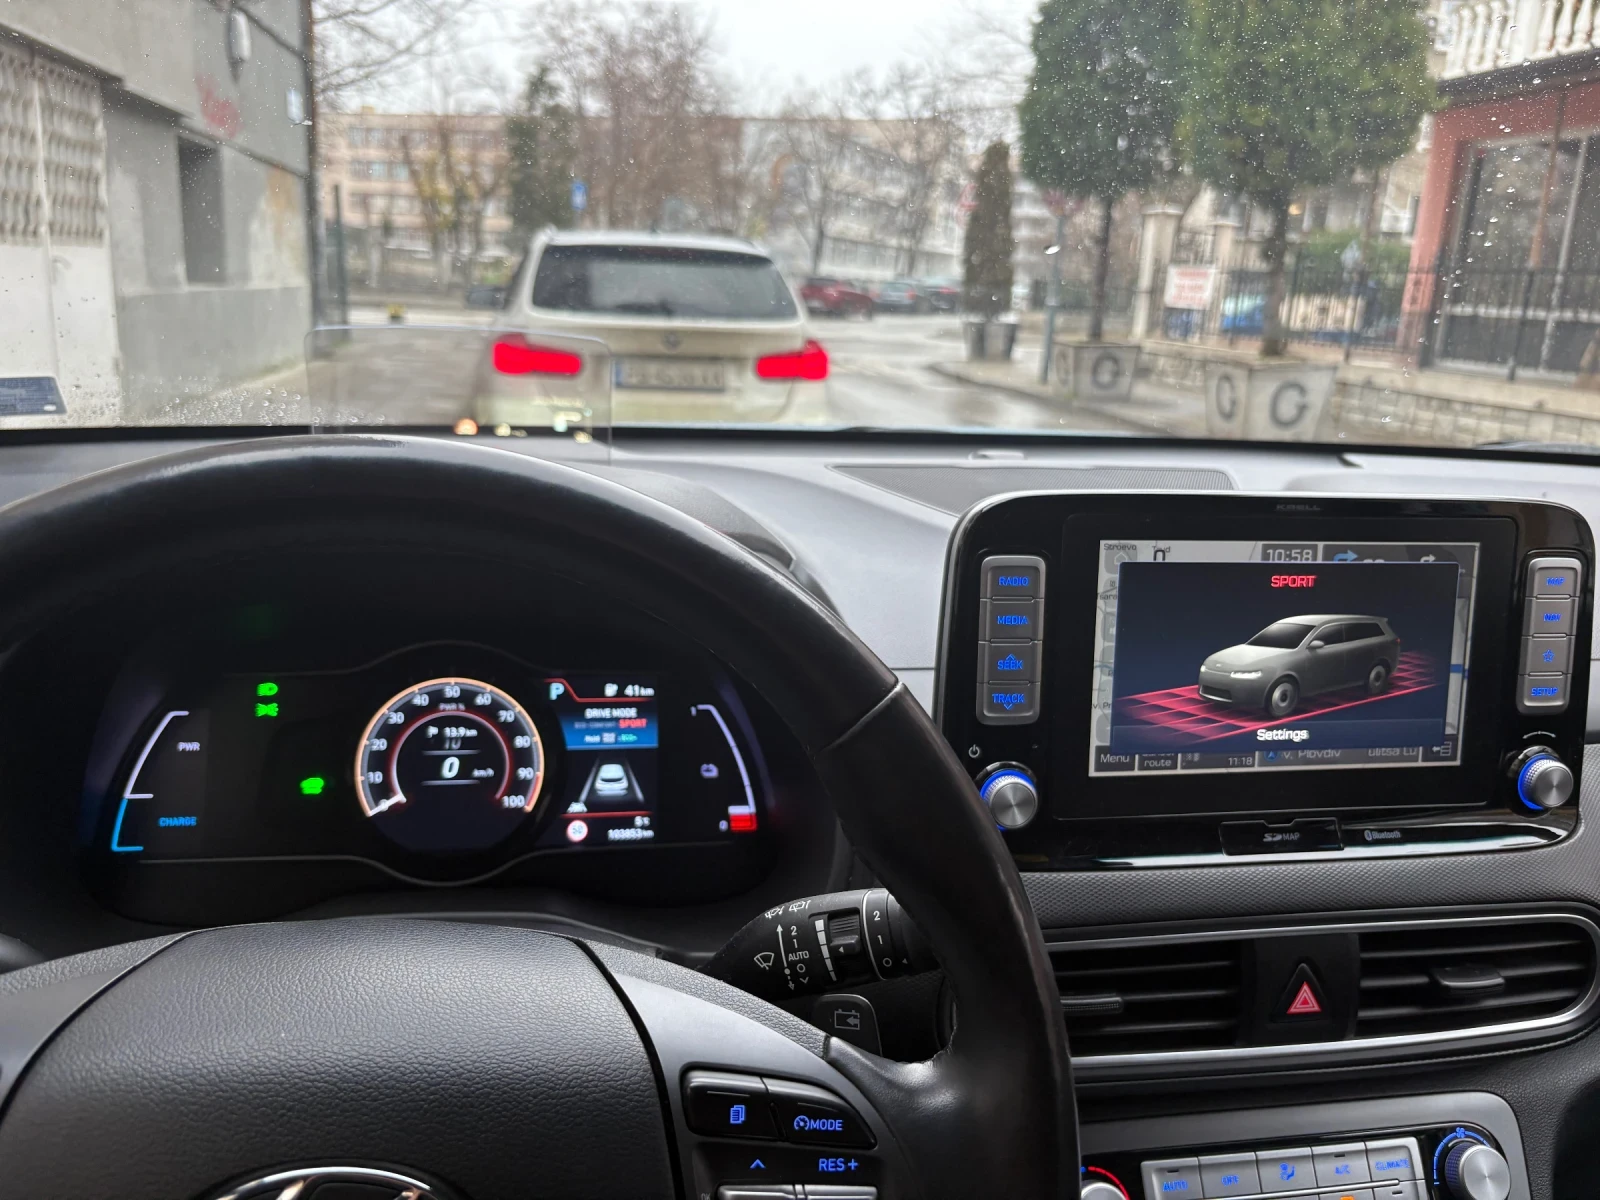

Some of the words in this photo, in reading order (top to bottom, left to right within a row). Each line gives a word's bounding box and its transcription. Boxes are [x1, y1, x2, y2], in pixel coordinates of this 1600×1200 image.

[1103, 543, 1137, 551] Stroevo
[1266, 549, 1313, 562] 10:58
[998, 576, 1030, 586] RADIO
[1270, 575, 1317, 588] SPORT
[997, 615, 1029, 625] MEDIA
[997, 660, 1023, 670] SEEK
[443, 685, 461, 699] 50
[550, 683, 565, 700] P
[1531, 687, 1558, 697] SETUP
[412, 693, 430, 707] 40
[474, 693, 492, 706] 60
[992, 693, 1025, 704] TRACK
[387, 711, 405, 725] 30
[498, 709, 516, 723] 70
[585, 708, 612, 719] DRIVE
[612, 707, 637, 718] MODE
[619, 718, 647, 728] SPORT
[1256, 728, 1309, 743] Settings
[177, 742, 200, 751] PWR
[370, 738, 387, 751] 20
[513, 735, 530, 749] 80
[1100, 753, 1130, 764] Menu
[1144, 759, 1172, 767] route
[1228, 756, 1253, 766] 11:18
[442, 757, 460, 778] 0
[517, 767, 534, 780] 90
[368, 771, 383, 784] 10
[502, 795, 525, 808] 100
[159, 817, 197, 827] CHARGE
[1283, 832, 1300, 841] MAP
[1371, 830, 1401, 840] Bluetooth
[873, 910, 881, 921] 2
[790, 925, 798, 936] 2
[792, 938, 798, 949] 1
[877, 935, 883, 945] 1
[788, 950, 810, 962] AUTO
[810, 1119, 843, 1131] MODE
[1375, 1158, 1411, 1171] CLIMATE
[1163, 1180, 1189, 1192] AUTO
